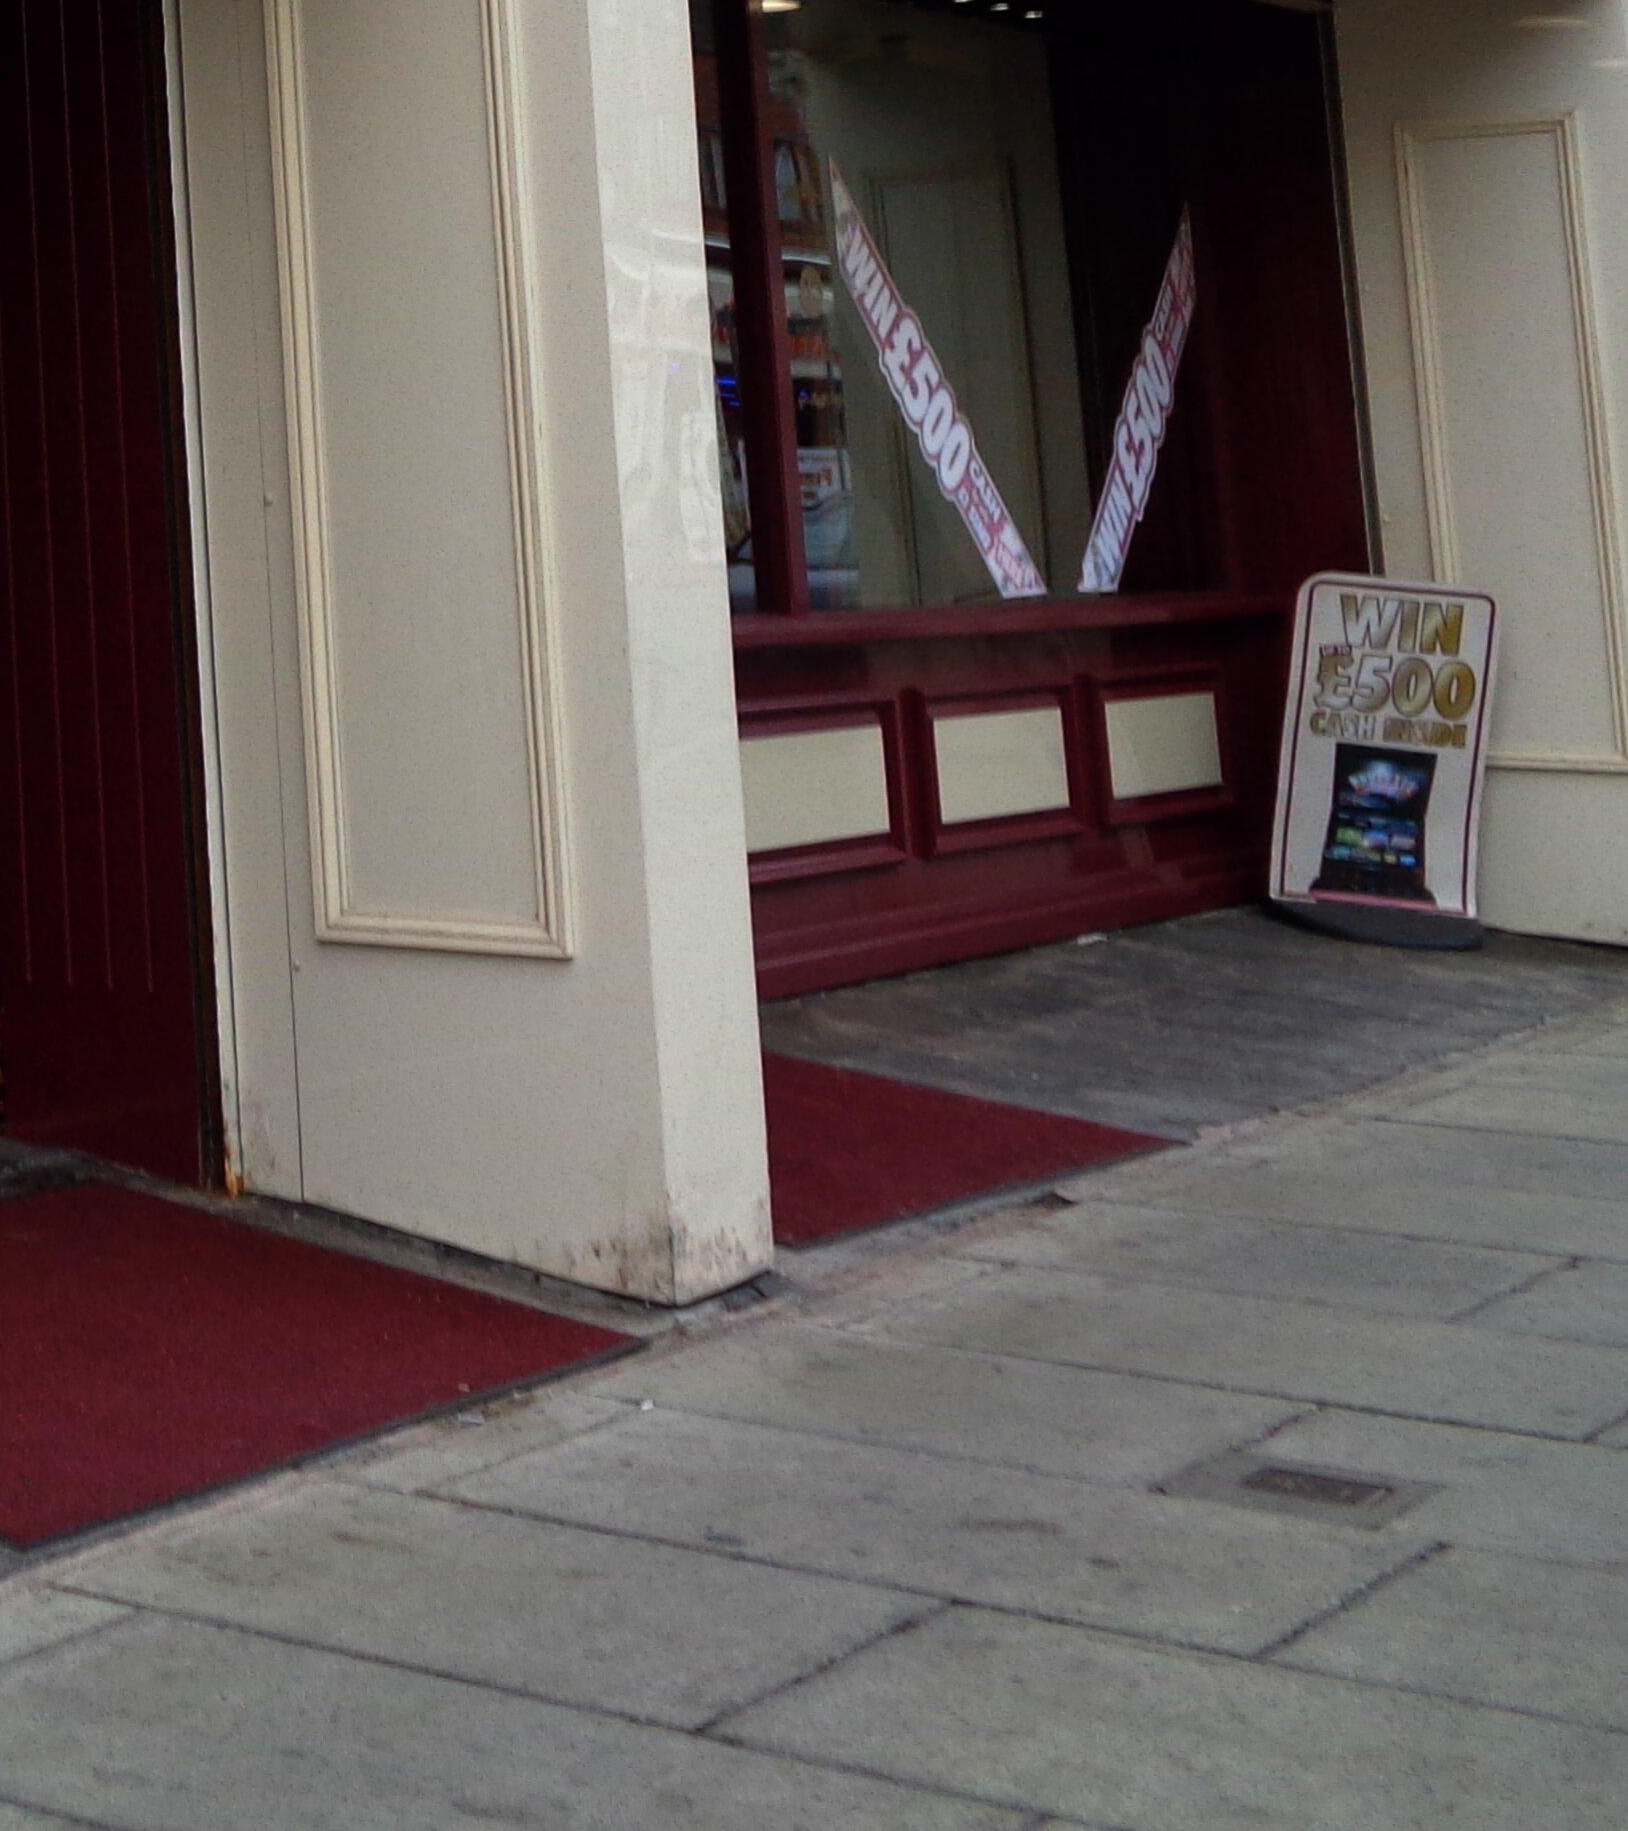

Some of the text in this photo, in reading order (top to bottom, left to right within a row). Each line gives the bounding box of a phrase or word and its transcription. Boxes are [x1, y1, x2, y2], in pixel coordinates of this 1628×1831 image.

[844, 225, 972, 491] WIN £500
[1339, 593, 1465, 657] WIN
[1314, 652, 1476, 719] £500
[1308, 710, 1468, 749] CASH INSIDE
